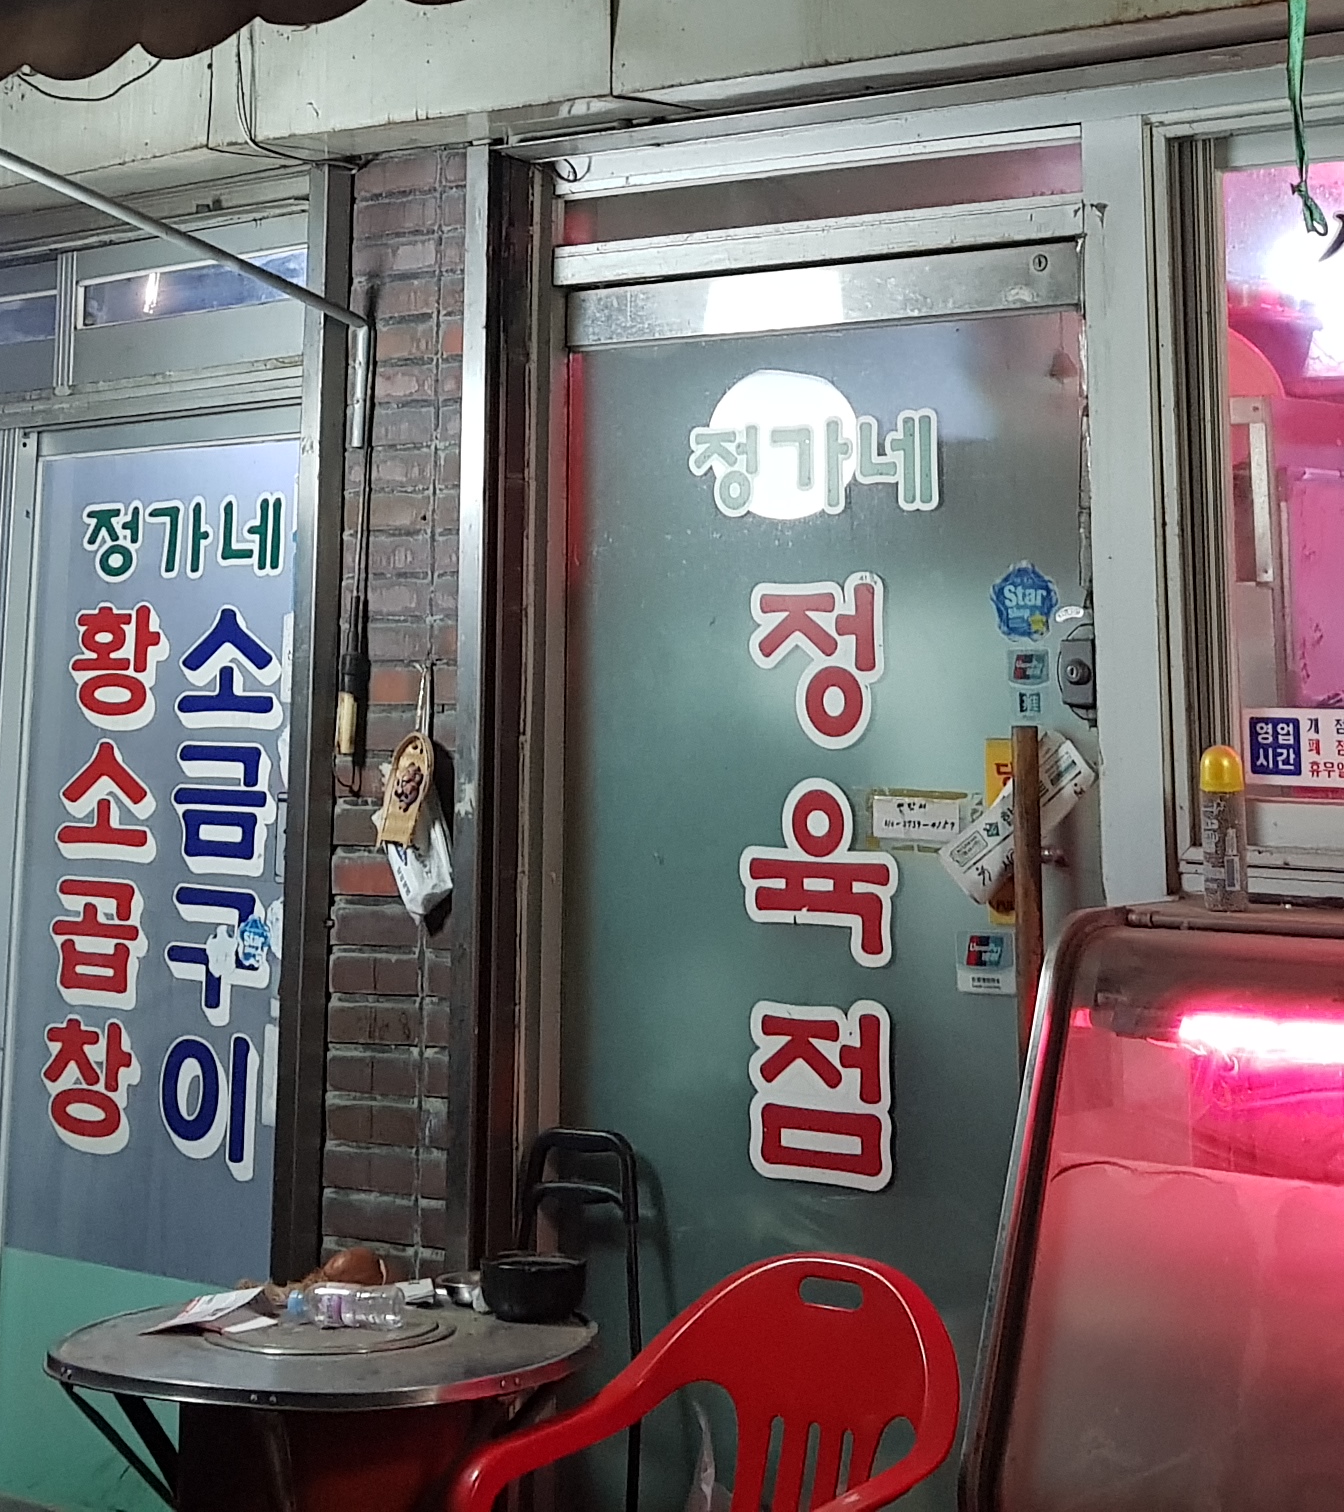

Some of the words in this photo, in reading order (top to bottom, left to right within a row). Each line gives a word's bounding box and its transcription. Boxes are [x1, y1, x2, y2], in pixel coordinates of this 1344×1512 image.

[690, 408, 940, 516] 정가네
[82, 494, 286, 580] 정가네
[1003, 584, 1047, 608] Star
[1255, 721, 1295, 745] 영업
[1256, 747, 1296, 770] 시간
[46, 600, 170, 1152] 황소곱창
[161, 606, 280, 1178] 소금구이
[743, 572, 897, 1190] 정육점
